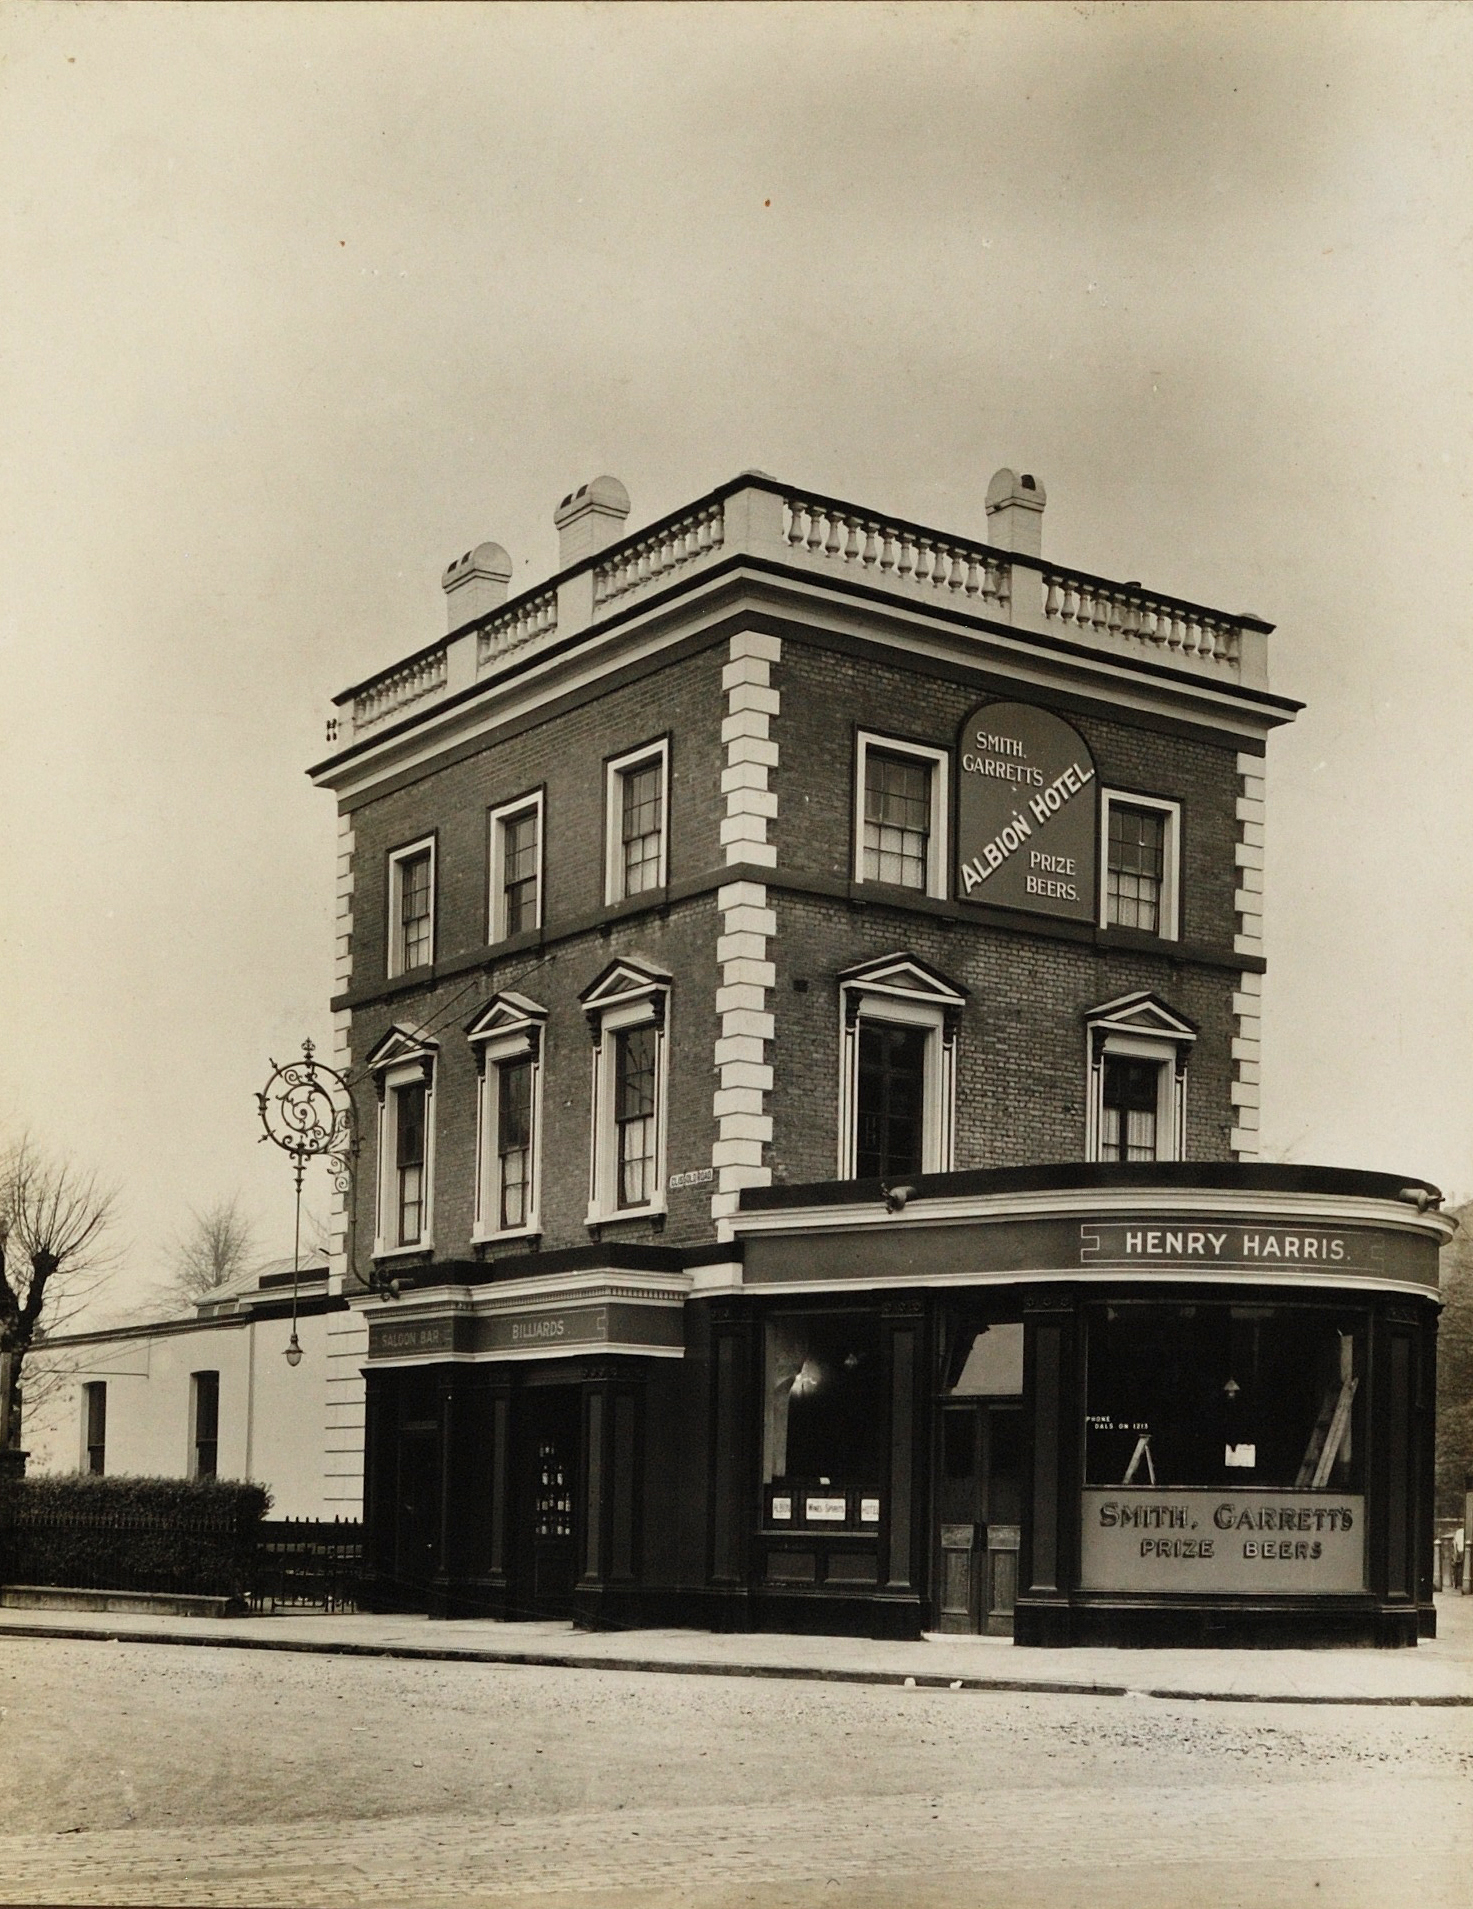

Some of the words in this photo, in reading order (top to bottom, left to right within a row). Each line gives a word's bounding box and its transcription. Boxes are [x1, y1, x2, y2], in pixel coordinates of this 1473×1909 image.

[962, 753, 1044, 787] GARRETT'S
[960, 814, 1032, 894] ALBION
[1029, 850, 1076, 876] PRIZE
[1125, 1231, 1228, 1255] HENRY
[1243, 1235, 1351, 1260] HARRIS.
[381, 1331, 416, 1347] SALOON
[420, 1329, 439, 1344] BAR
[1140, 1538, 1215, 1559] PRIZE
[1242, 1540, 1323, 1560] BEERS
